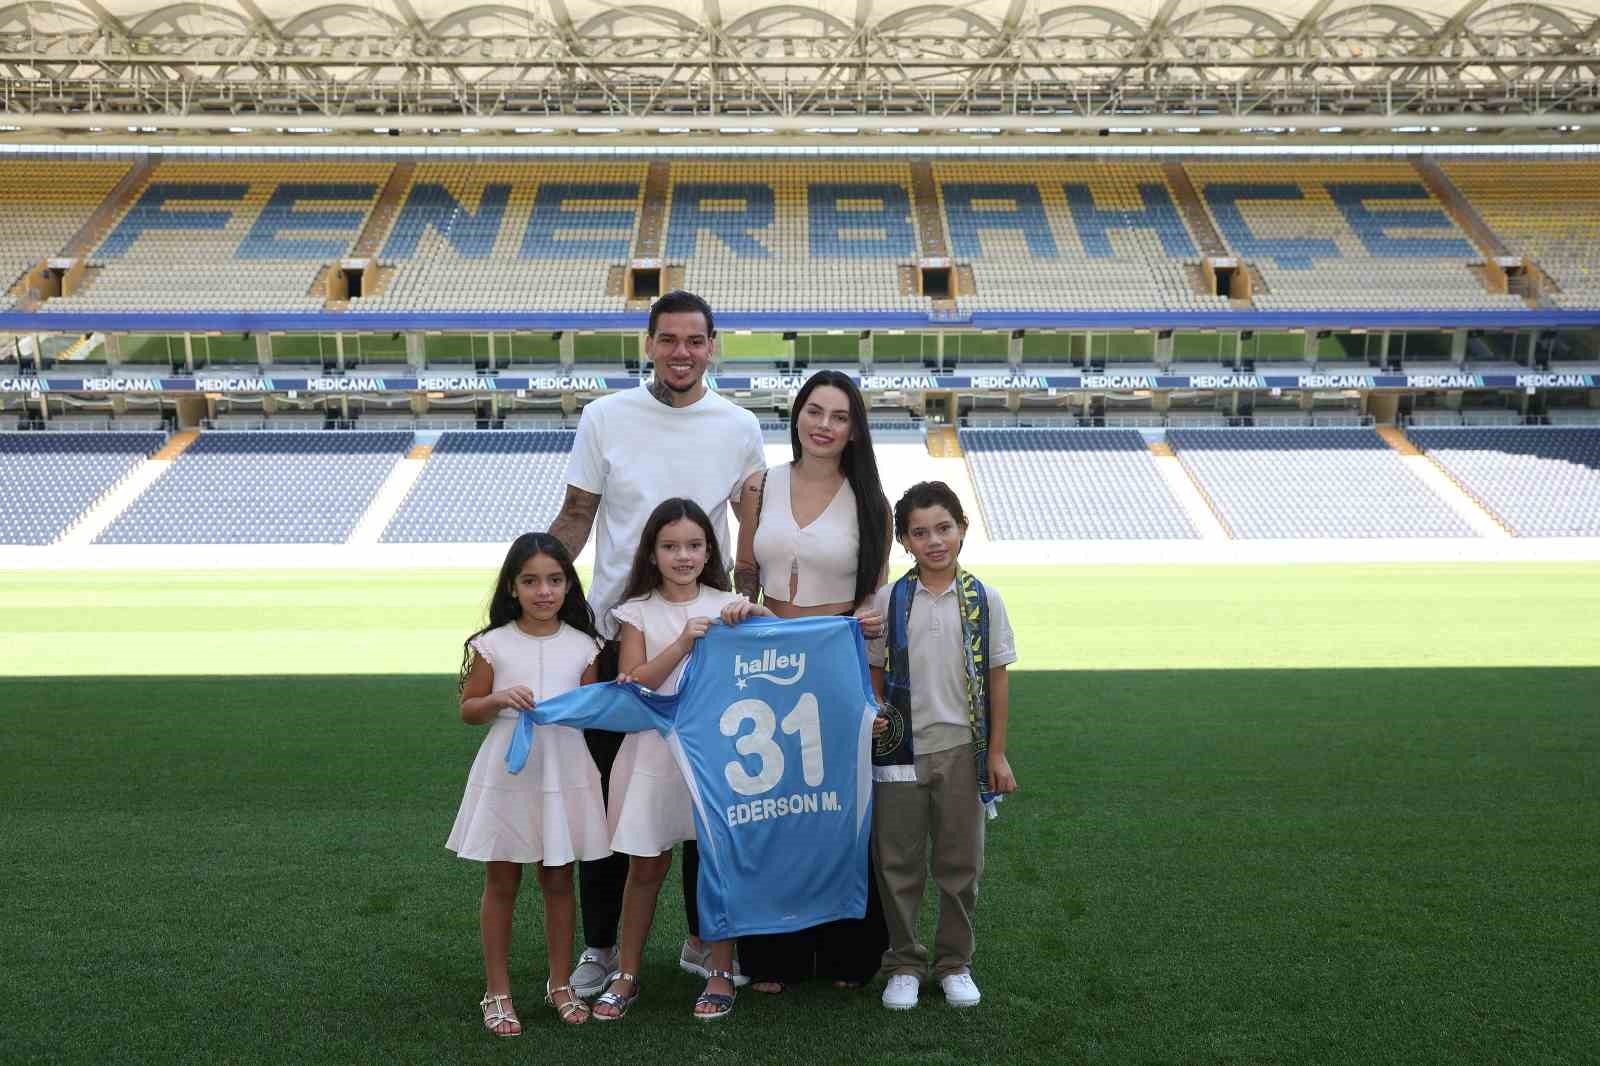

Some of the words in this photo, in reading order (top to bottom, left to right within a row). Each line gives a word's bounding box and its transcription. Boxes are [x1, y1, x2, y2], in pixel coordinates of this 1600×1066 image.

[82, 378, 153, 391] MEDICANA
[195, 377, 265, 390] MEDICANA
[307, 377, 376, 390] MEDICANA
[417, 377, 487, 390] MEDICANA
[528, 377, 598, 390] MEDICANA
[860, 376, 930, 389] MEDICANA
[970, 375, 1040, 388] MEDICANA
[1080, 375, 1149, 388] MEDICANA
[1189, 375, 1257, 388] MEDICANA
[1299, 374, 1367, 387] MEDICANA
[1407, 374, 1475, 387] MEDICANA
[1516, 374, 1584, 387] MEDICANA
[734, 649, 806, 686] halley
[719, 692, 825, 795] 31
[727, 794, 818, 828] EDERSON
[821, 791, 842, 813] M.
